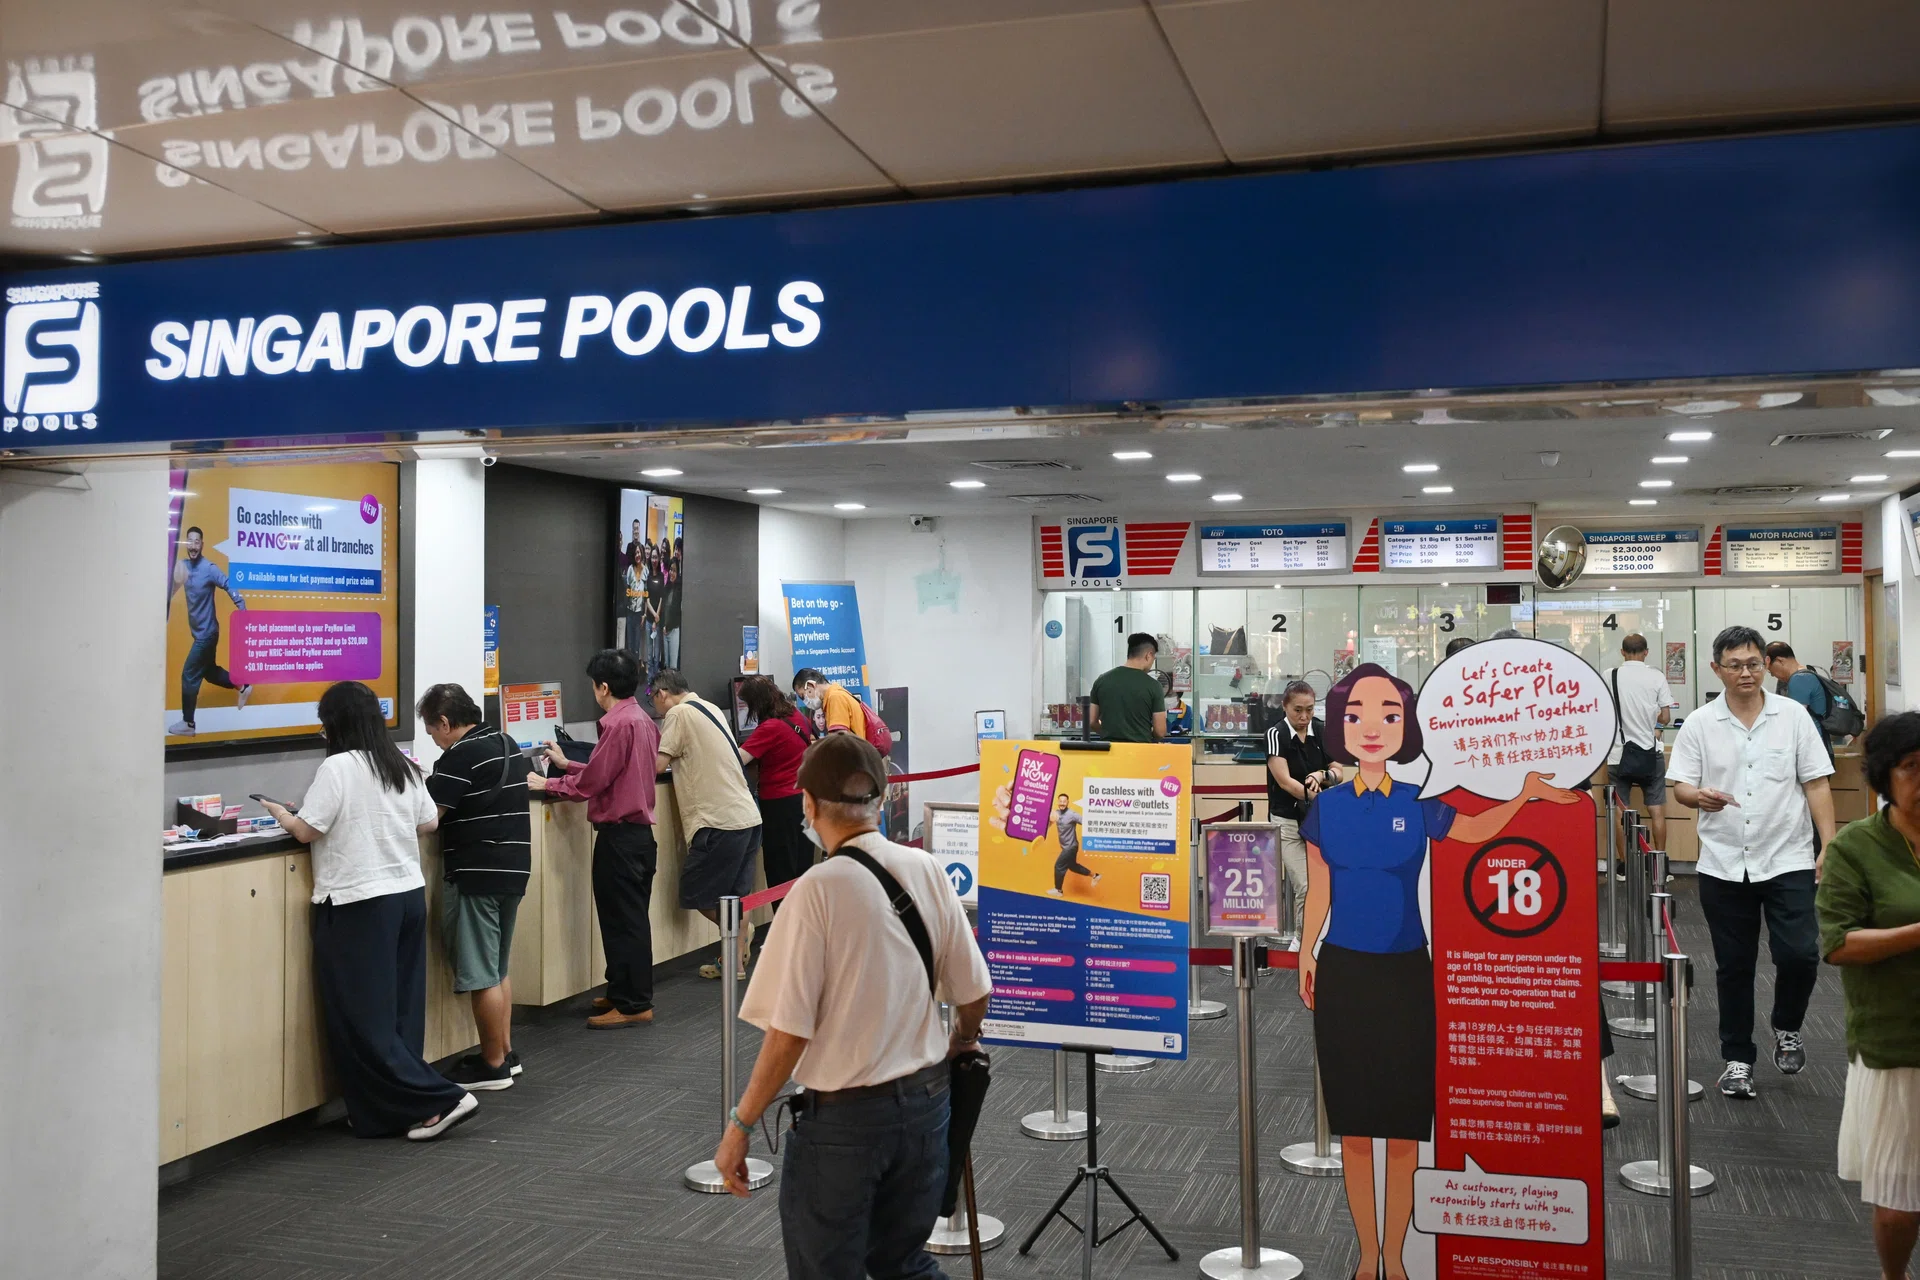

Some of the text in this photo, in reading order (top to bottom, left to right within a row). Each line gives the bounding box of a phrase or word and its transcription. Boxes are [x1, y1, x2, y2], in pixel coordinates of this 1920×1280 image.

[6, 281, 100, 303] SINGAPORE
[144, 280, 825, 381] SINGAPORE POOLS
[3, 413, 97, 432] POOLS
[362, 502, 377, 518] NEW
[237, 506, 322, 529] Go cashless with
[1067, 517, 1118, 525] SINGAPORE
[237, 531, 373, 555] PAYNOW at all branches
[248, 572, 275, 582] Available
[290, 574, 298, 583] for
[300, 575, 309, 584] bet
[310, 576, 334, 586] payment
[335, 576, 345, 585] and
[346, 576, 358, 586] prize
[360, 577, 374, 586] claim
[1071, 579, 1122, 587] POOLS
[791, 598, 838, 610] Bet on the go
[793, 614, 825, 627] anytime,
[1115, 616, 1123, 633] 1
[1272, 614, 1286, 632] 2
[1440, 613, 1455, 632] 3
[1603, 614, 1618, 631] 4
[1767, 614, 1782, 631] 5
[249, 624, 257, 632] For
[259, 624, 268, 632] bet
[269, 624, 296, 633] placement
[298, 625, 304, 633] up
[312, 625, 323, 633] your
[325, 624, 343, 633] PayNow
[344, 624, 355, 632] limit
[794, 631, 829, 643] anywhere
[248, 662, 323, 671] $0.10 transaction fee applies
[1462, 659, 1552, 681] Let's Create
[1443, 674, 1580, 708] a Safer Play
[1429, 698, 1598, 730] Environment Together!
[1453, 725, 1588, 752] 请与我们齐心协力建立
[1023, 758, 1044, 770] PAY
[1021, 768, 1052, 782] NOW
[1089, 785, 1154, 796] Go cashless with
[1163, 781, 1178, 792] NEW
[1089, 798, 1169, 809] PAYNOW @outlets
[1228, 834, 1255, 842] TOTO
[1488, 859, 1526, 868] UNDER
[1225, 869, 1263, 896] 2.5
[1488, 870, 1542, 916] 18
[1223, 899, 1263, 908] MILLION
[1462, 951, 1485, 961] illegal
[1488, 952, 1498, 960] for
[1500, 953, 1513, 962] any
[1516, 954, 1542, 963] person
[1544, 954, 1566, 963] under
[1569, 955, 1582, 964] the
[1494, 964, 1534, 975] participate
[1537, 965, 1544, 973] in
[1546, 966, 1560, 975] any
[1562, 966, 1580, 974] form
[1457, 974, 1494, 984] gambling,
[1496, 976, 1531, 986] including
[1533, 977, 1552, 986] prize
[1554, 978, 1582, 986] claims.
[1447, 985, 1576, 998] We seek your co-operation that id
[1448, 997, 1556, 1010] verification may be required.
[1449, 1021, 1582, 1036] 未满18岁的人士参与任何形式的
[1445, 1179, 1558, 1199] As customers, playing
[1430, 1195, 1574, 1215] responsibly starts with you.
[1453, 1254, 1475, 1264] PLAY
[1478, 1256, 1538, 1269] RESPONSIBLY
